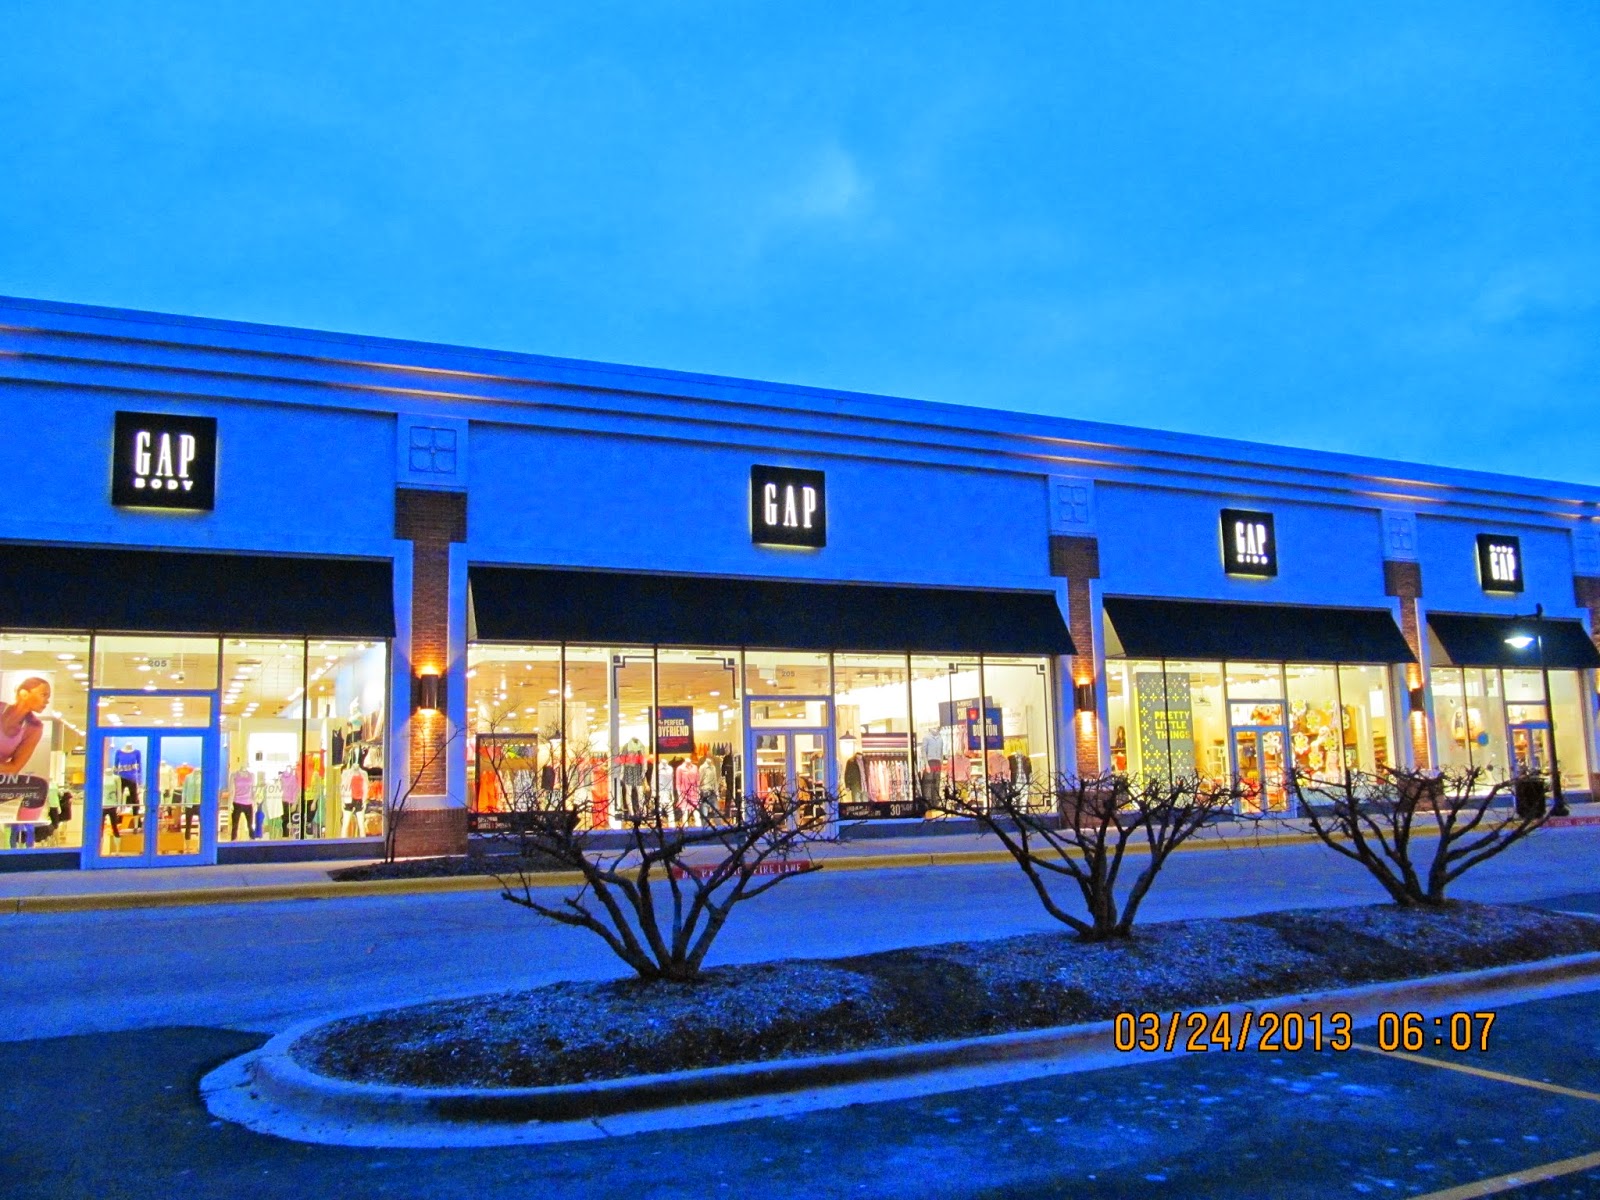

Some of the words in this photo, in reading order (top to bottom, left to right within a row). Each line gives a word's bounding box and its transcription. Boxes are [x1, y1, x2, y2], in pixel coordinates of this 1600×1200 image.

[134, 431, 196, 478] GAP
[133, 478, 194, 491] BODY
[764, 483, 816, 528] GAP
[1235, 521, 1266, 555] GAP
[1490, 552, 1515, 581] GAP
[148, 660, 167, 668] 205
[1154, 710, 1190, 720] PRETTY
[663, 718, 685, 726] PERFECT
[1155, 720, 1187, 730] LITTLE
[656, 725, 690, 737] OYFRIEND
[972, 724, 998, 737] BUTON
[1156, 730, 1191, 740] THINGS
[890, 803, 901, 817] 30
